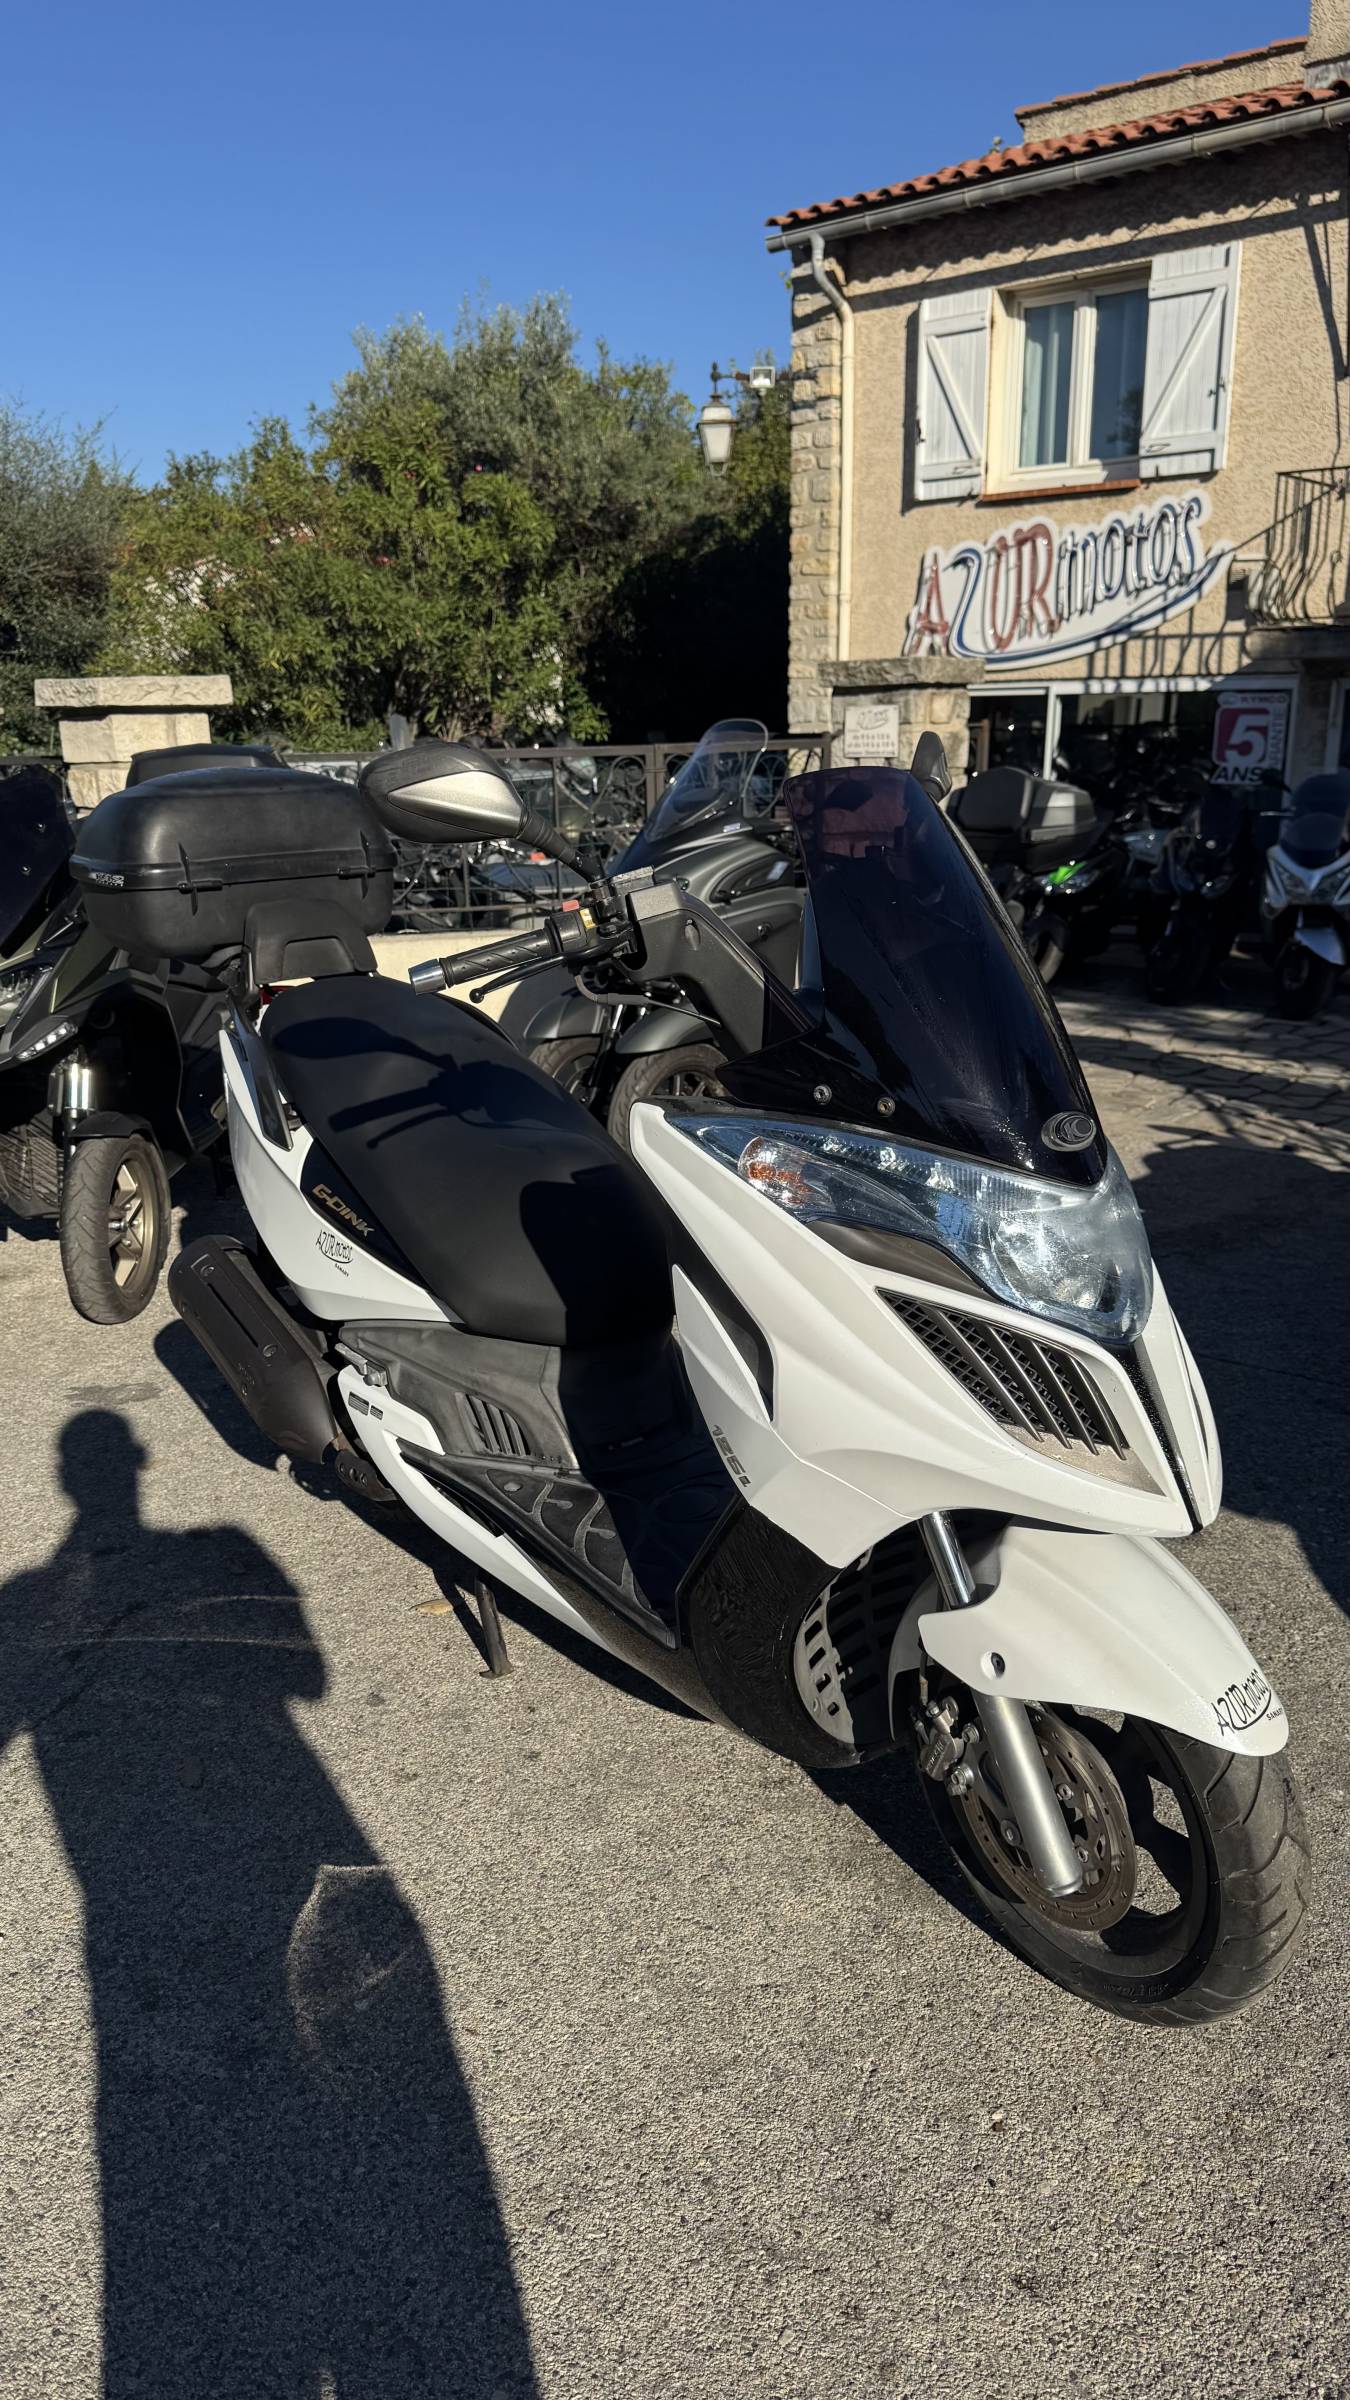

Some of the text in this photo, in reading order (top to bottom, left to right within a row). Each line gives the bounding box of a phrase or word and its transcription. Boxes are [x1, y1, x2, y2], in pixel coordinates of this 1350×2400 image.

[1225, 713, 1266, 764] 5
[1268, 706, 1284, 769] ARANTIE
[1214, 765, 1263, 783] ANS
